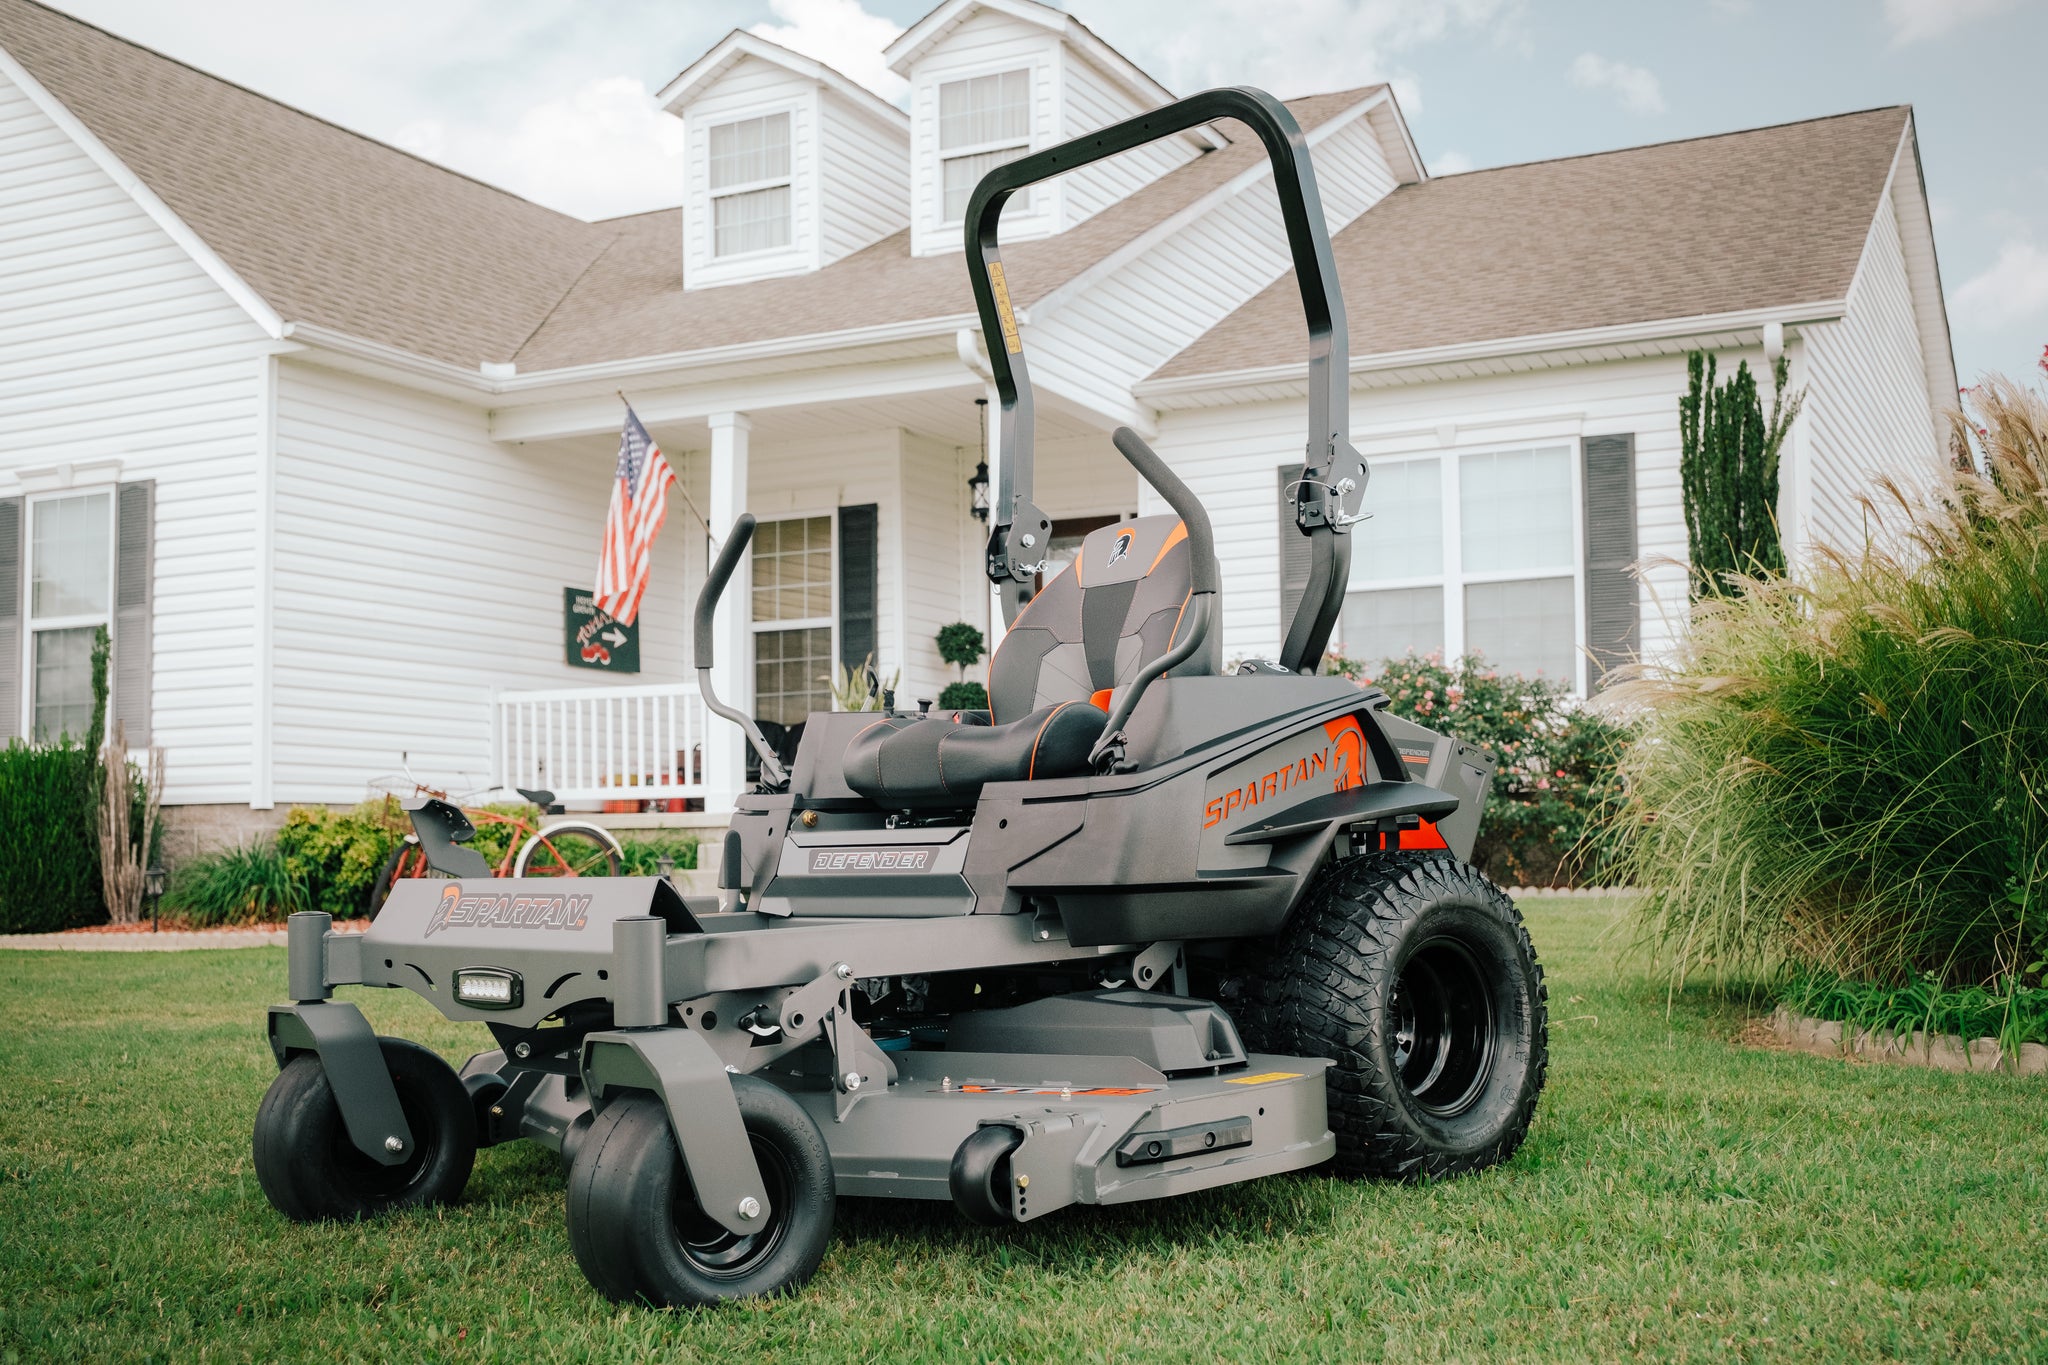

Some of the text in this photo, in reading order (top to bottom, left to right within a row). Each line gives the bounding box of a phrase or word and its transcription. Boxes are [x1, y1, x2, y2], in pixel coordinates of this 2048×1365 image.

[1204, 748, 1327, 829] SPARTAN
[813, 851, 928, 870] DEFENDER
[449, 897, 589, 926] SPARTAN
